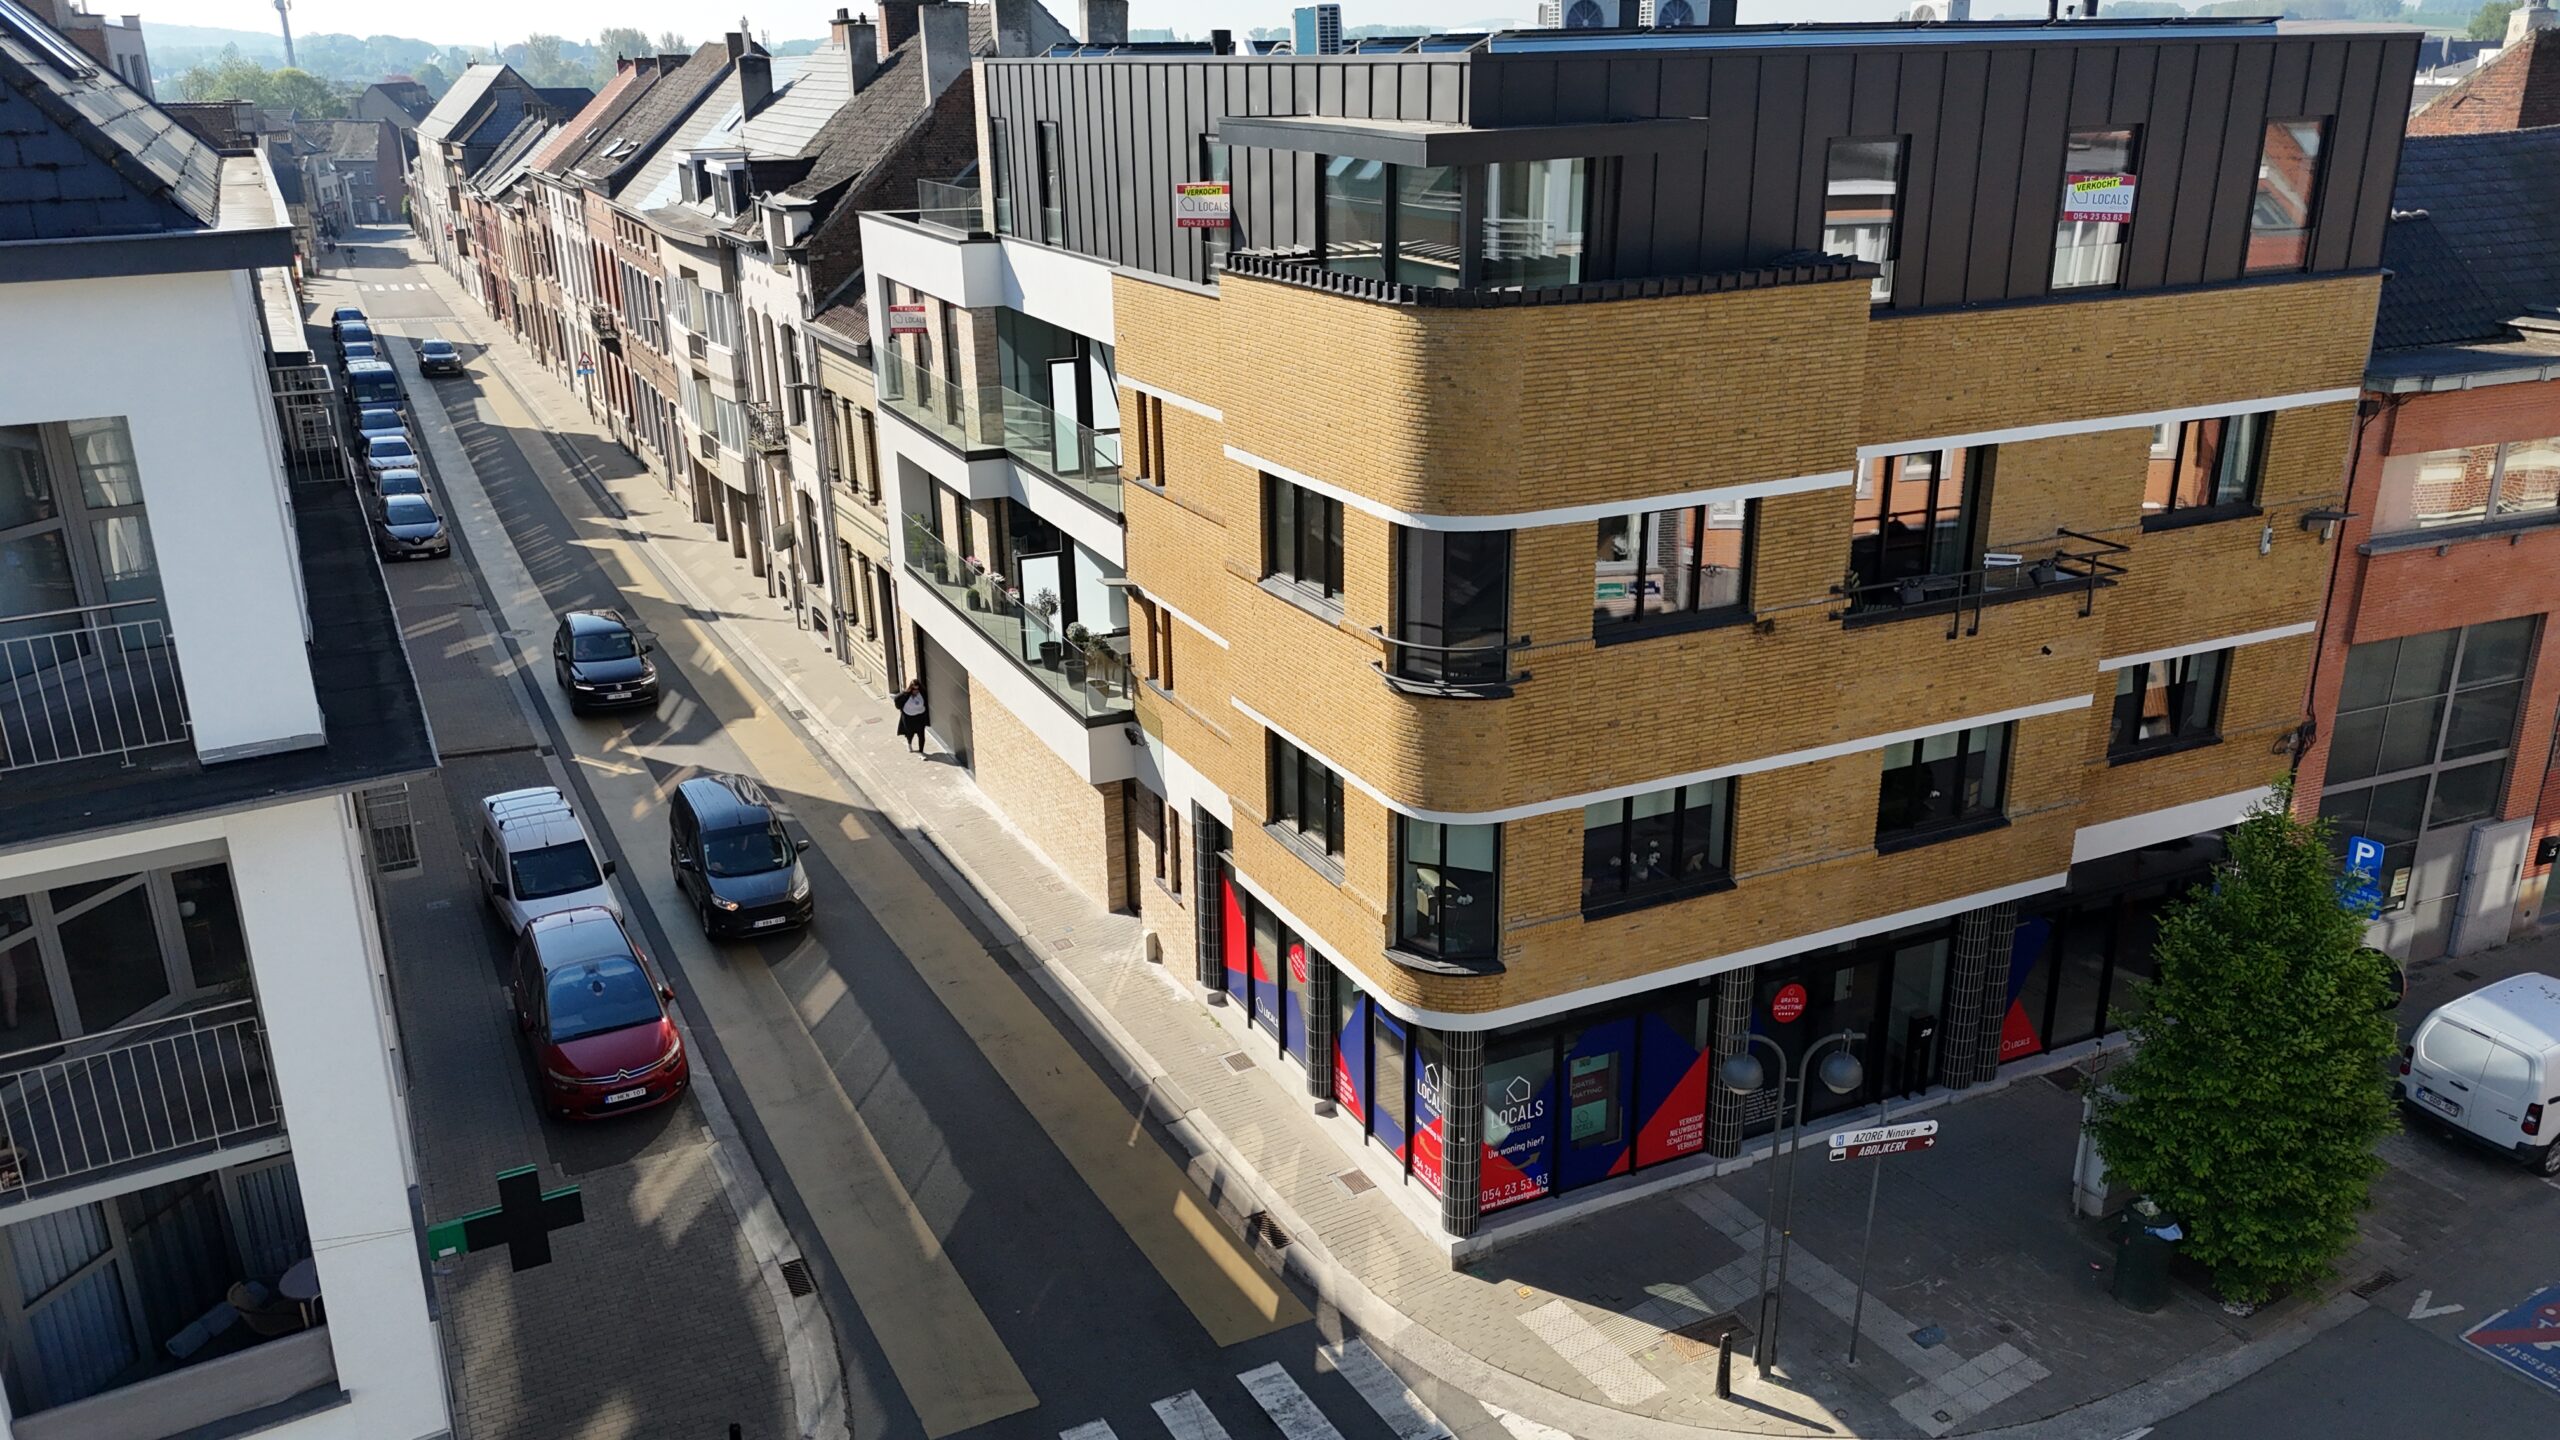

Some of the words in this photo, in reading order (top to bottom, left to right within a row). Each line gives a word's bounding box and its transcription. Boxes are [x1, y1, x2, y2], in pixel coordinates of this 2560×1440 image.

[1186, 188, 1221, 196] VERKOCHT
[2076, 179, 2118, 191] VERKOCHT
[1198, 201, 1229, 212] LOCALS
[2092, 193, 2130, 205] LOCALS
[2073, 212, 2088, 220] 054
[2355, 841, 2375, 864] P
[1263, 1007, 1279, 1029] LOCAL
[2011, 1037, 2030, 1049] LOCALS
[1417, 1078, 1442, 1114] LOCAL
[1491, 1100, 1544, 1129] LOCALS
[1679, 1114, 1704, 1127] VERKOOP
[1669, 1122, 1703, 1137] NIEUWBOUW
[1853, 1130, 1884, 1144] AZORG
[1886, 1127, 1917, 1139] Ninove
[1666, 1130, 1703, 1147] SCHATTINGEN
[1677, 1138, 1702, 1151] VERHUUR
[1488, 1150, 1499, 1159] Uw
[1500, 1142, 1525, 1155] woning
[1527, 1136, 1545, 1148] hier?
[1858, 1140, 1908, 1157] ABDIJKERK
[1482, 1187, 1501, 1202] 054
[1504, 1182, 1517, 1196] 23
[1520, 1178, 1532, 1191] 53
[1536, 1173, 1549, 1186] 83
